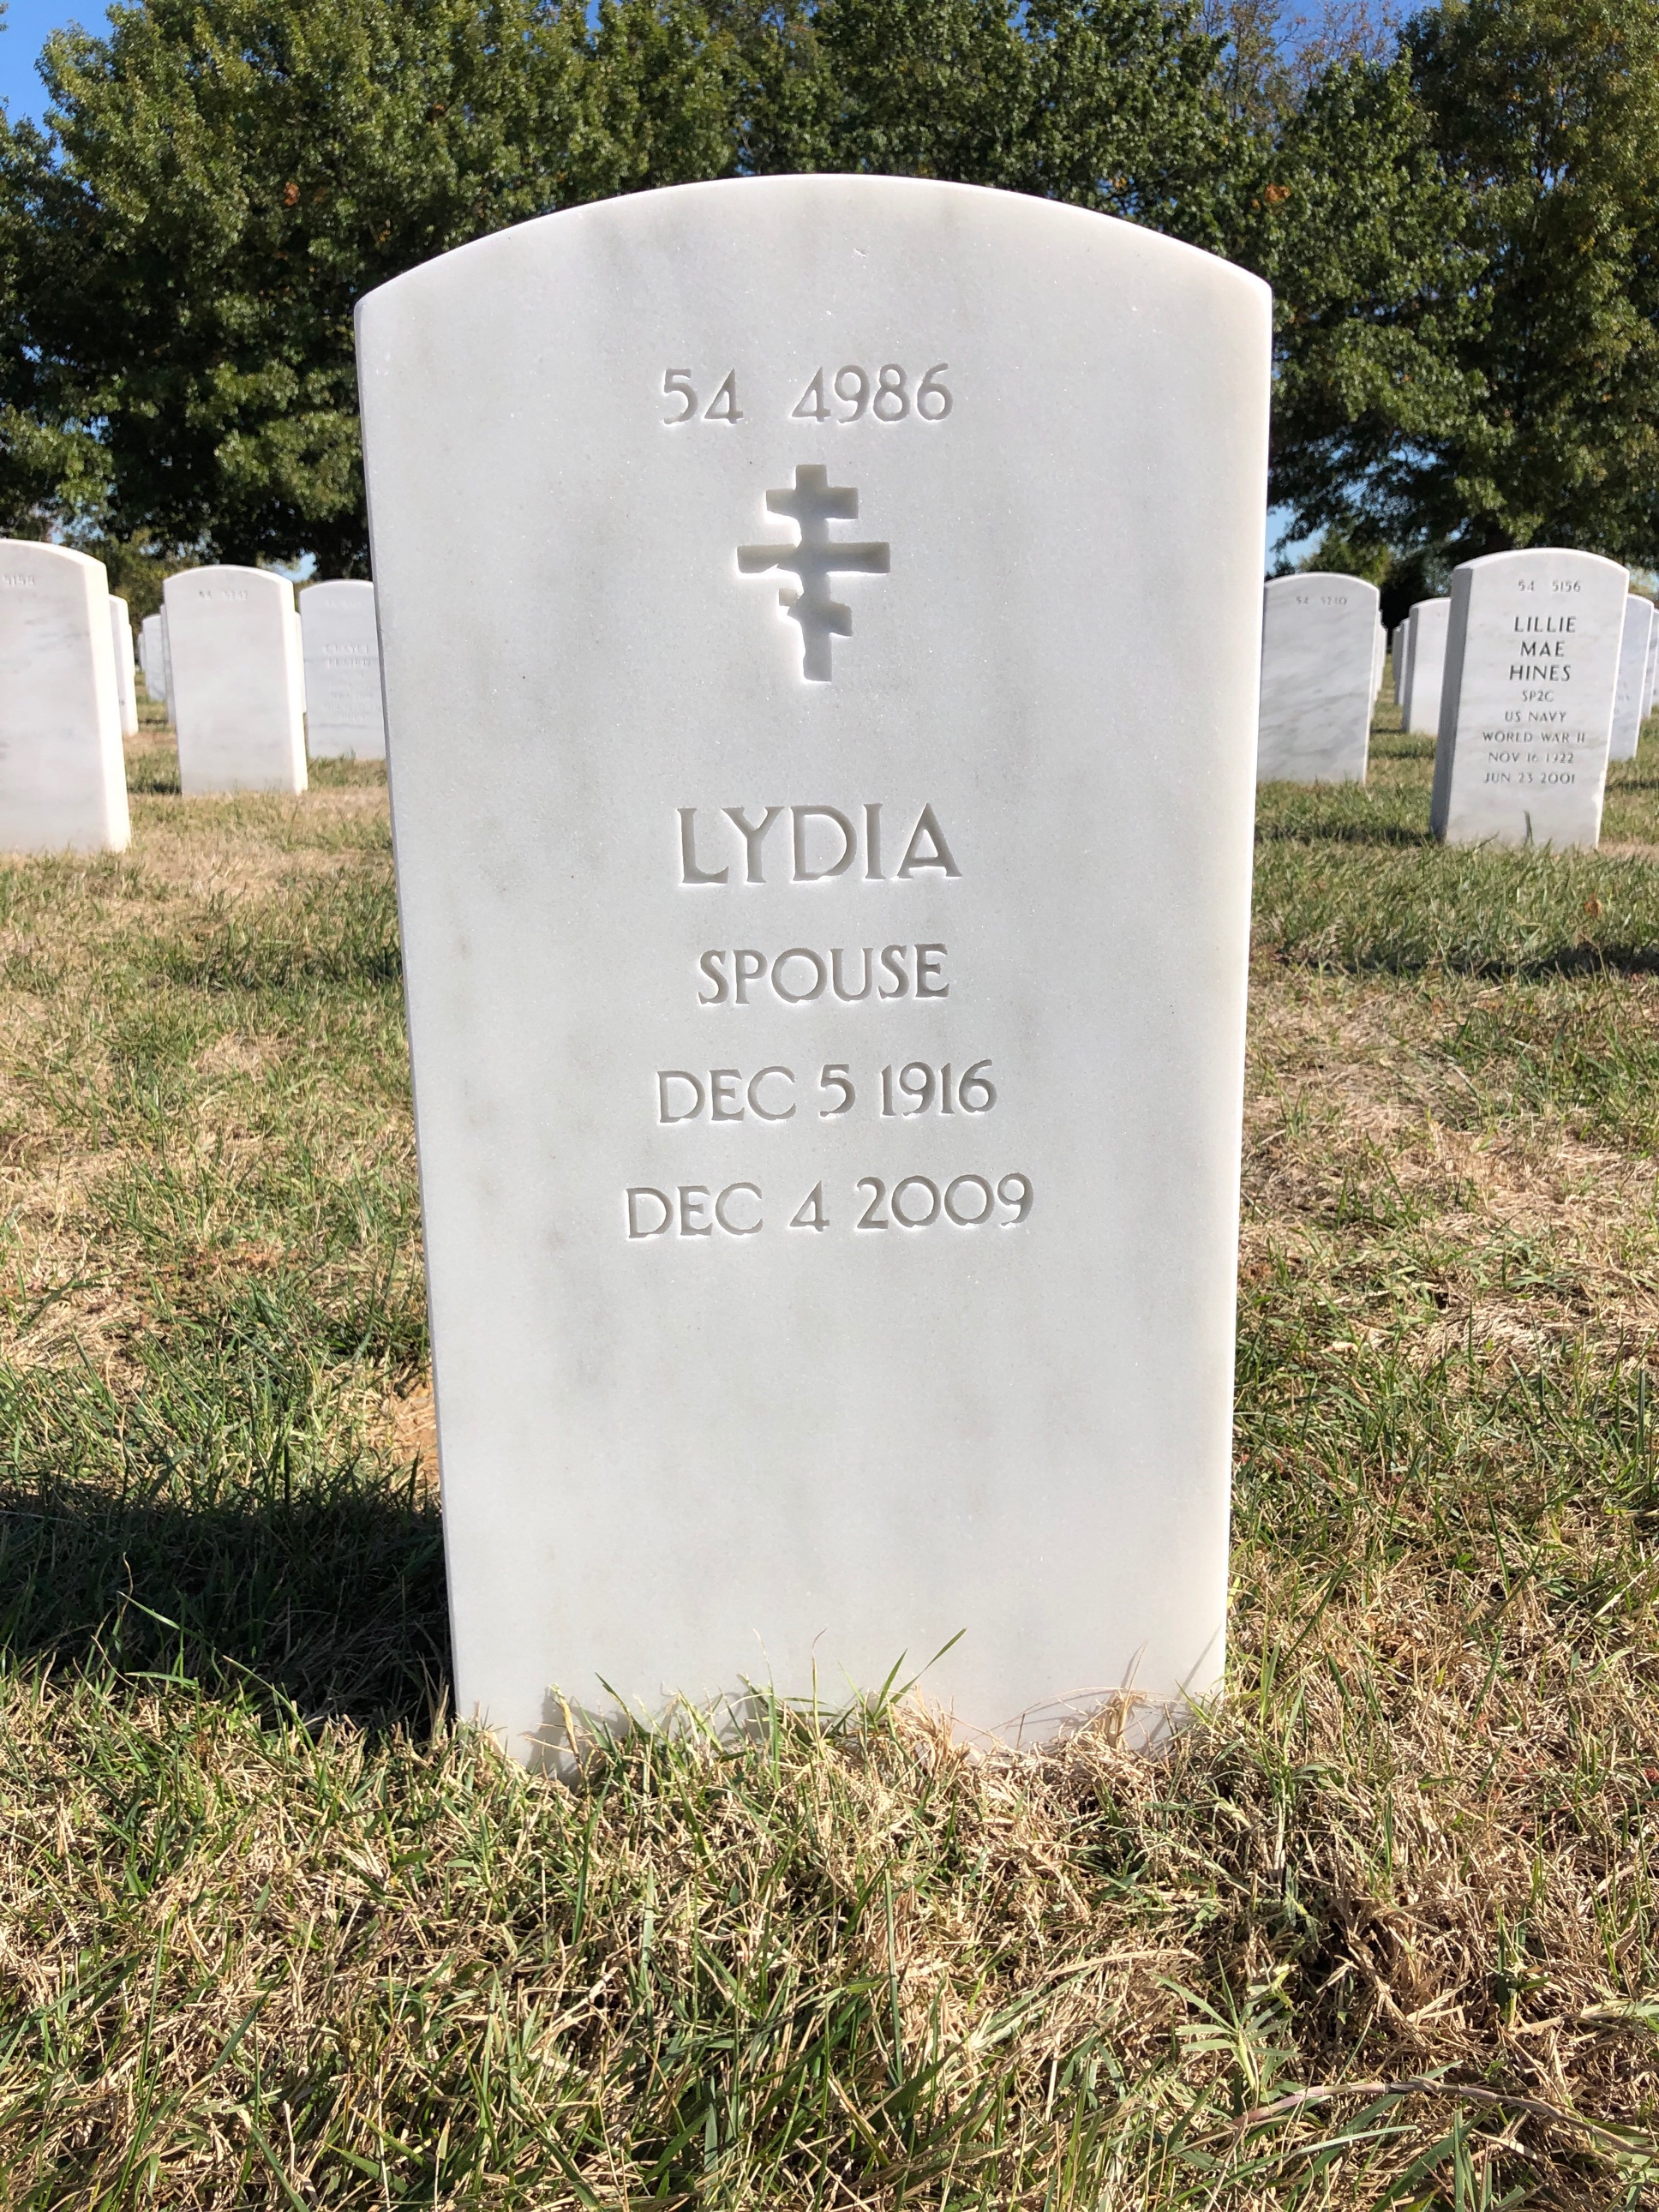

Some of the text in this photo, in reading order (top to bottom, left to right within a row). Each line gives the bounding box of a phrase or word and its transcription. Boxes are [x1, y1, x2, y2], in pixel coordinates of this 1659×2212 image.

[663, 363, 954, 424] 54 4986
[1518, 579, 1581, 593] 54 5156
[1513, 615, 1577, 633] LILLIE
[1520, 640, 1566, 658] MAE
[1509, 664, 1572, 682] HINES
[1521, 689, 1554, 703] SP2C
[1504, 710, 1567, 723] US NAVY
[1482, 730, 1585, 744] WORLD WAR II
[1488, 751, 1519, 764] NOV
[1483, 771, 1511, 784] JUN
[1541, 771, 1576, 785] 2001
[677, 801, 963, 884] LYDIA
[698, 943, 950, 1005] SPOUSE
[656, 1058, 997, 1124] DEC 5 1916
[625, 1172, 1034, 1238] DEC 4 2009
